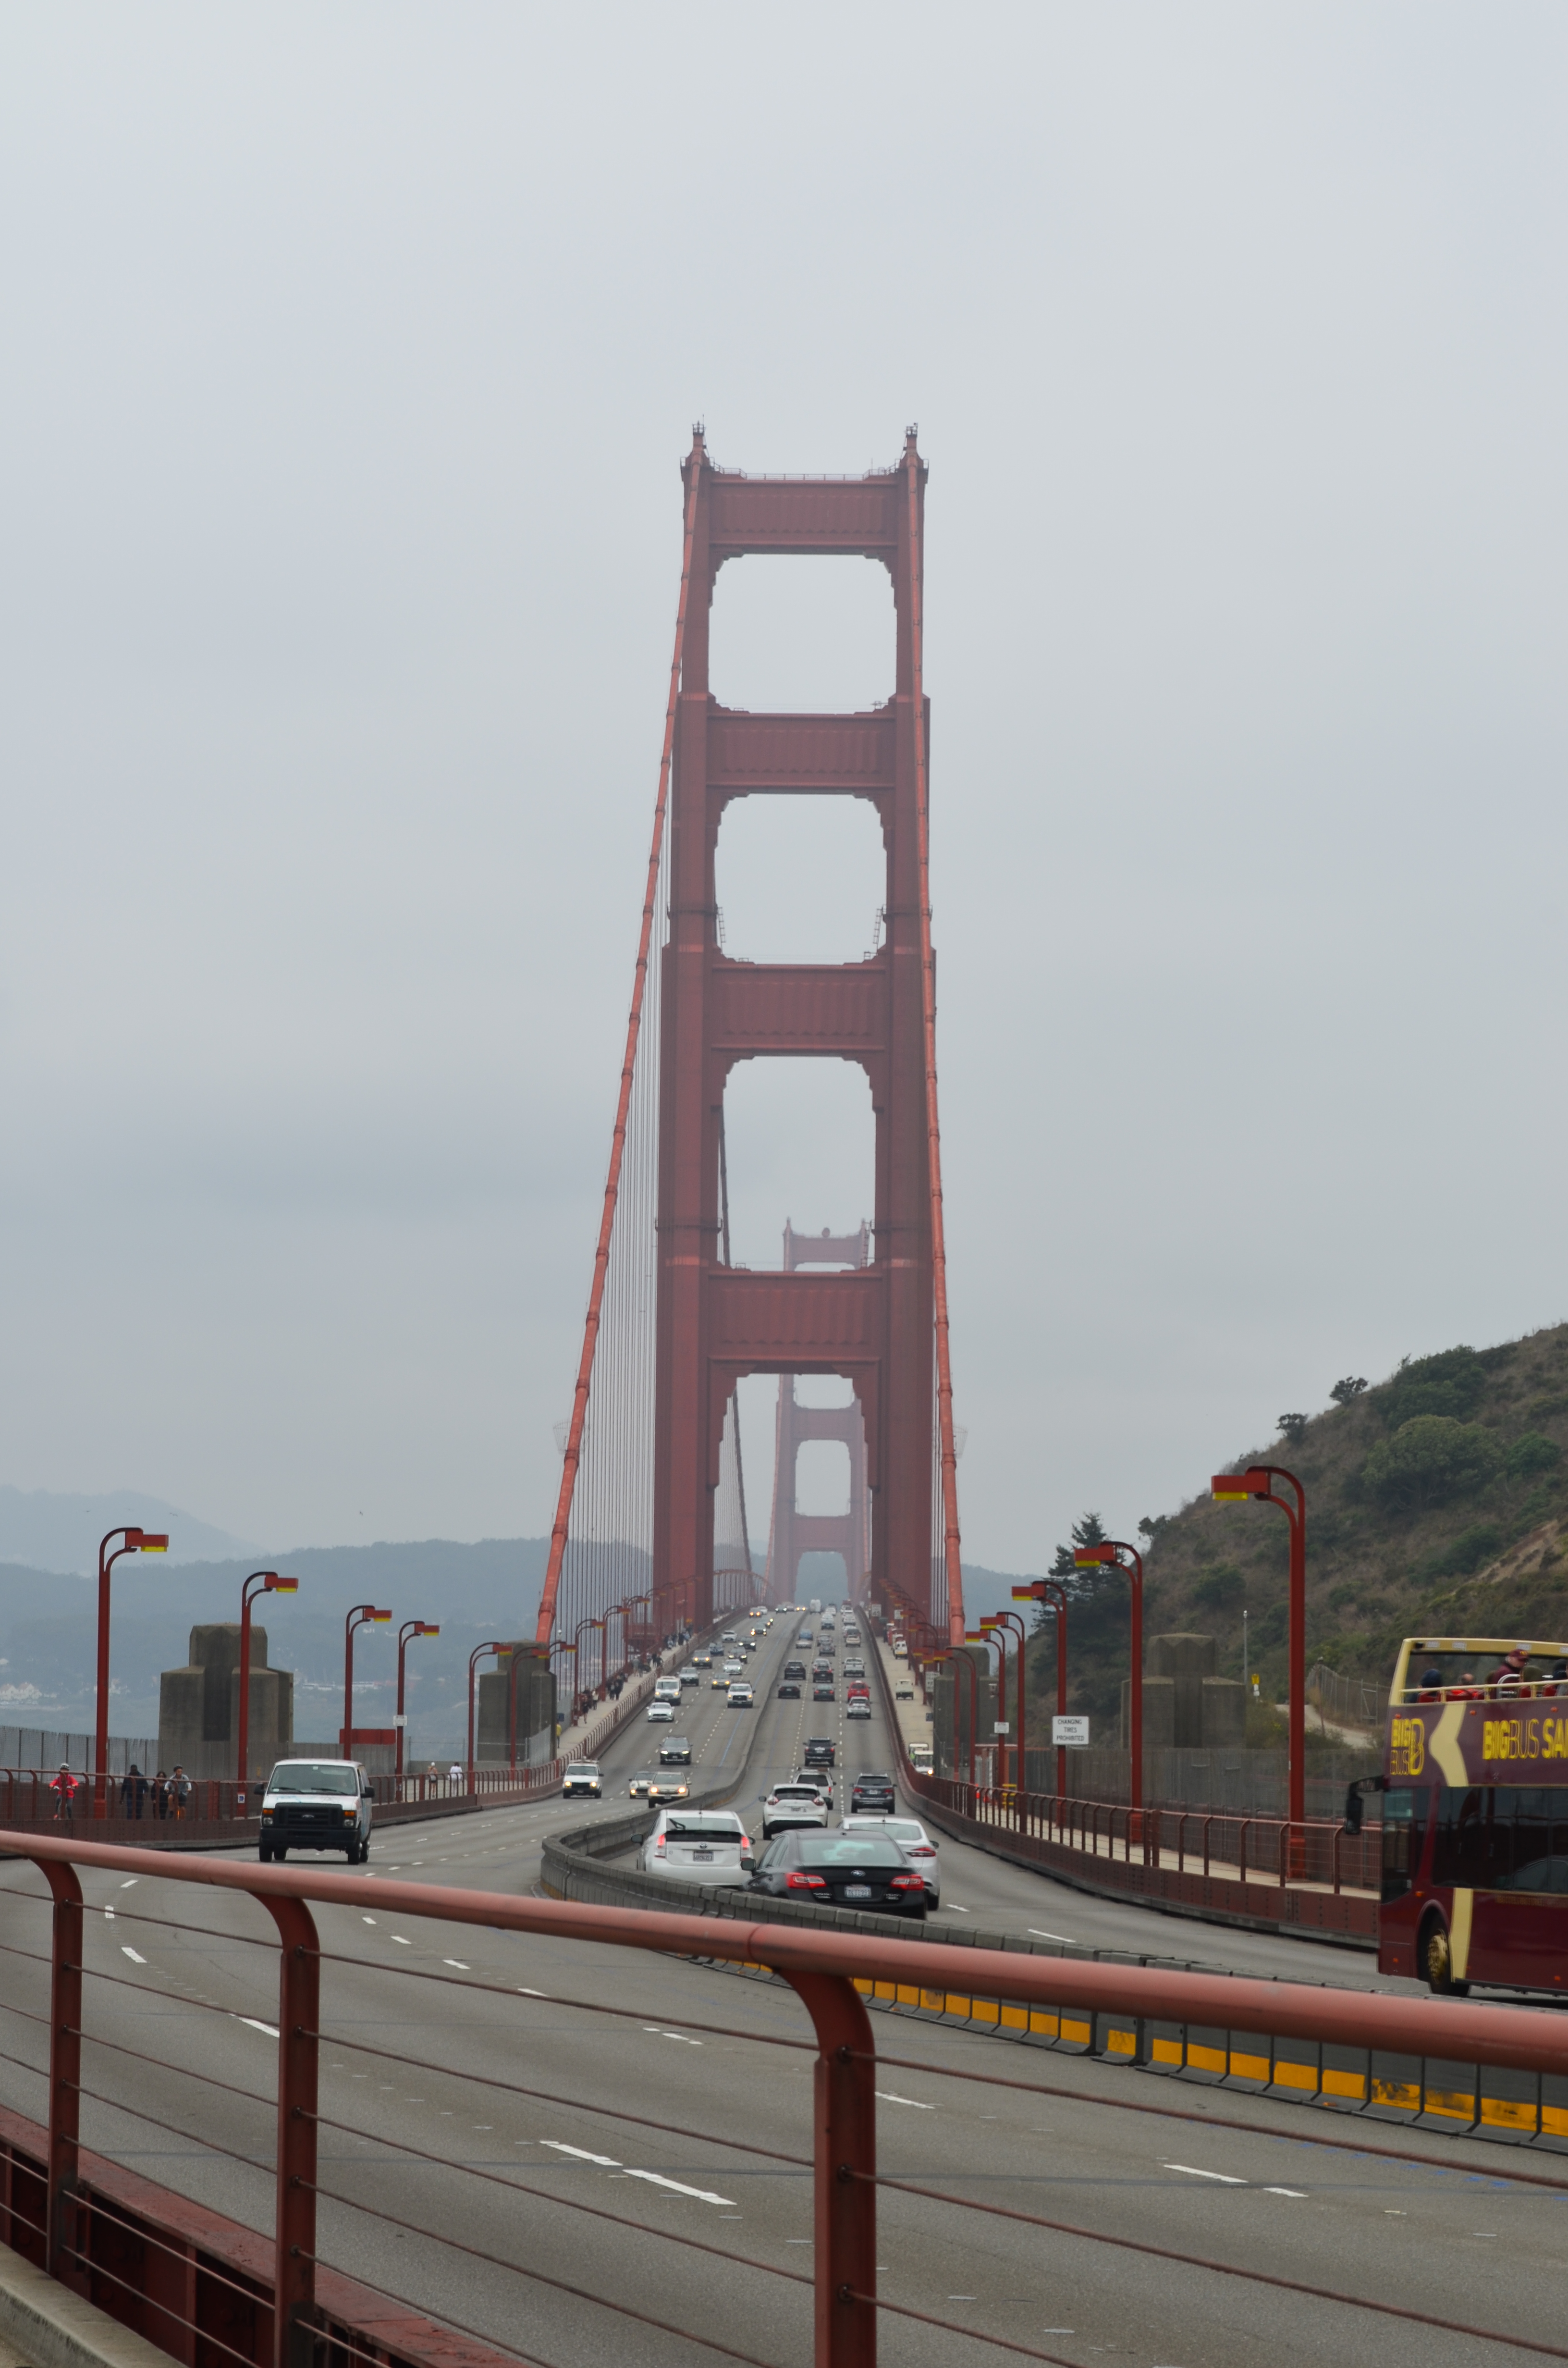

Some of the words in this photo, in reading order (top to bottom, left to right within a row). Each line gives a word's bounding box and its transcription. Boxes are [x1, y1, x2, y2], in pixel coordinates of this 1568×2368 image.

[1391, 1718, 1410, 1747] BIG
[1542, 1718, 1568, 1759] SA
[1390, 1750, 1410, 1775] BUS
